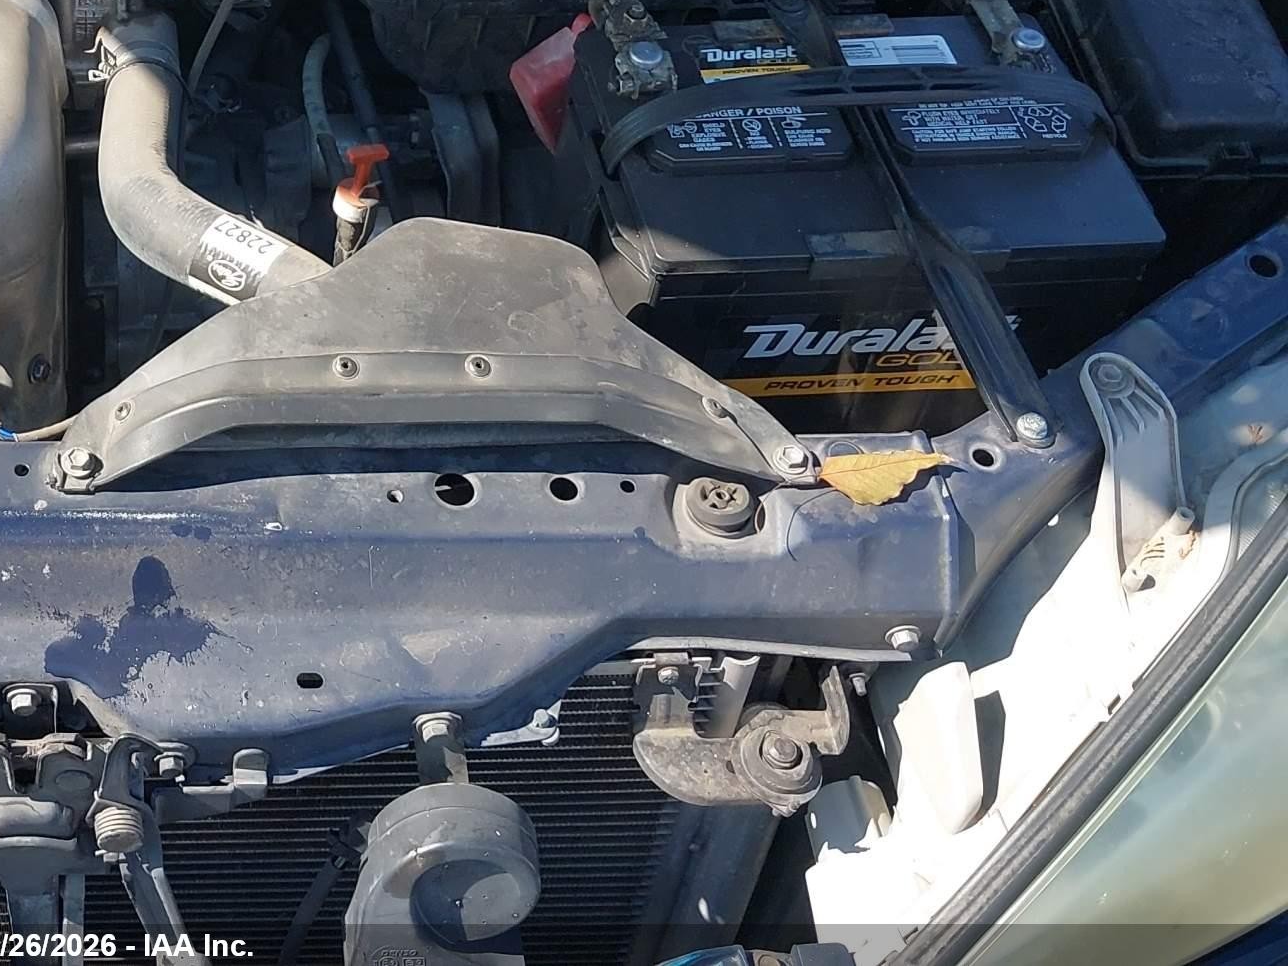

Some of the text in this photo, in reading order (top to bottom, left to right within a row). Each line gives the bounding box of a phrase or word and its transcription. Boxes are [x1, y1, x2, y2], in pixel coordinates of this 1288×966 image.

[699, 45, 798, 63] Duralast
[695, 108, 744, 119] ANGER
[755, 106, 803, 116] POISON
[213, 219, 273, 255] 22827
[743, 315, 1020, 359] Durala
[876, 352, 962, 368] GOL
[764, 374, 959, 392] PROVEN TOUGH
